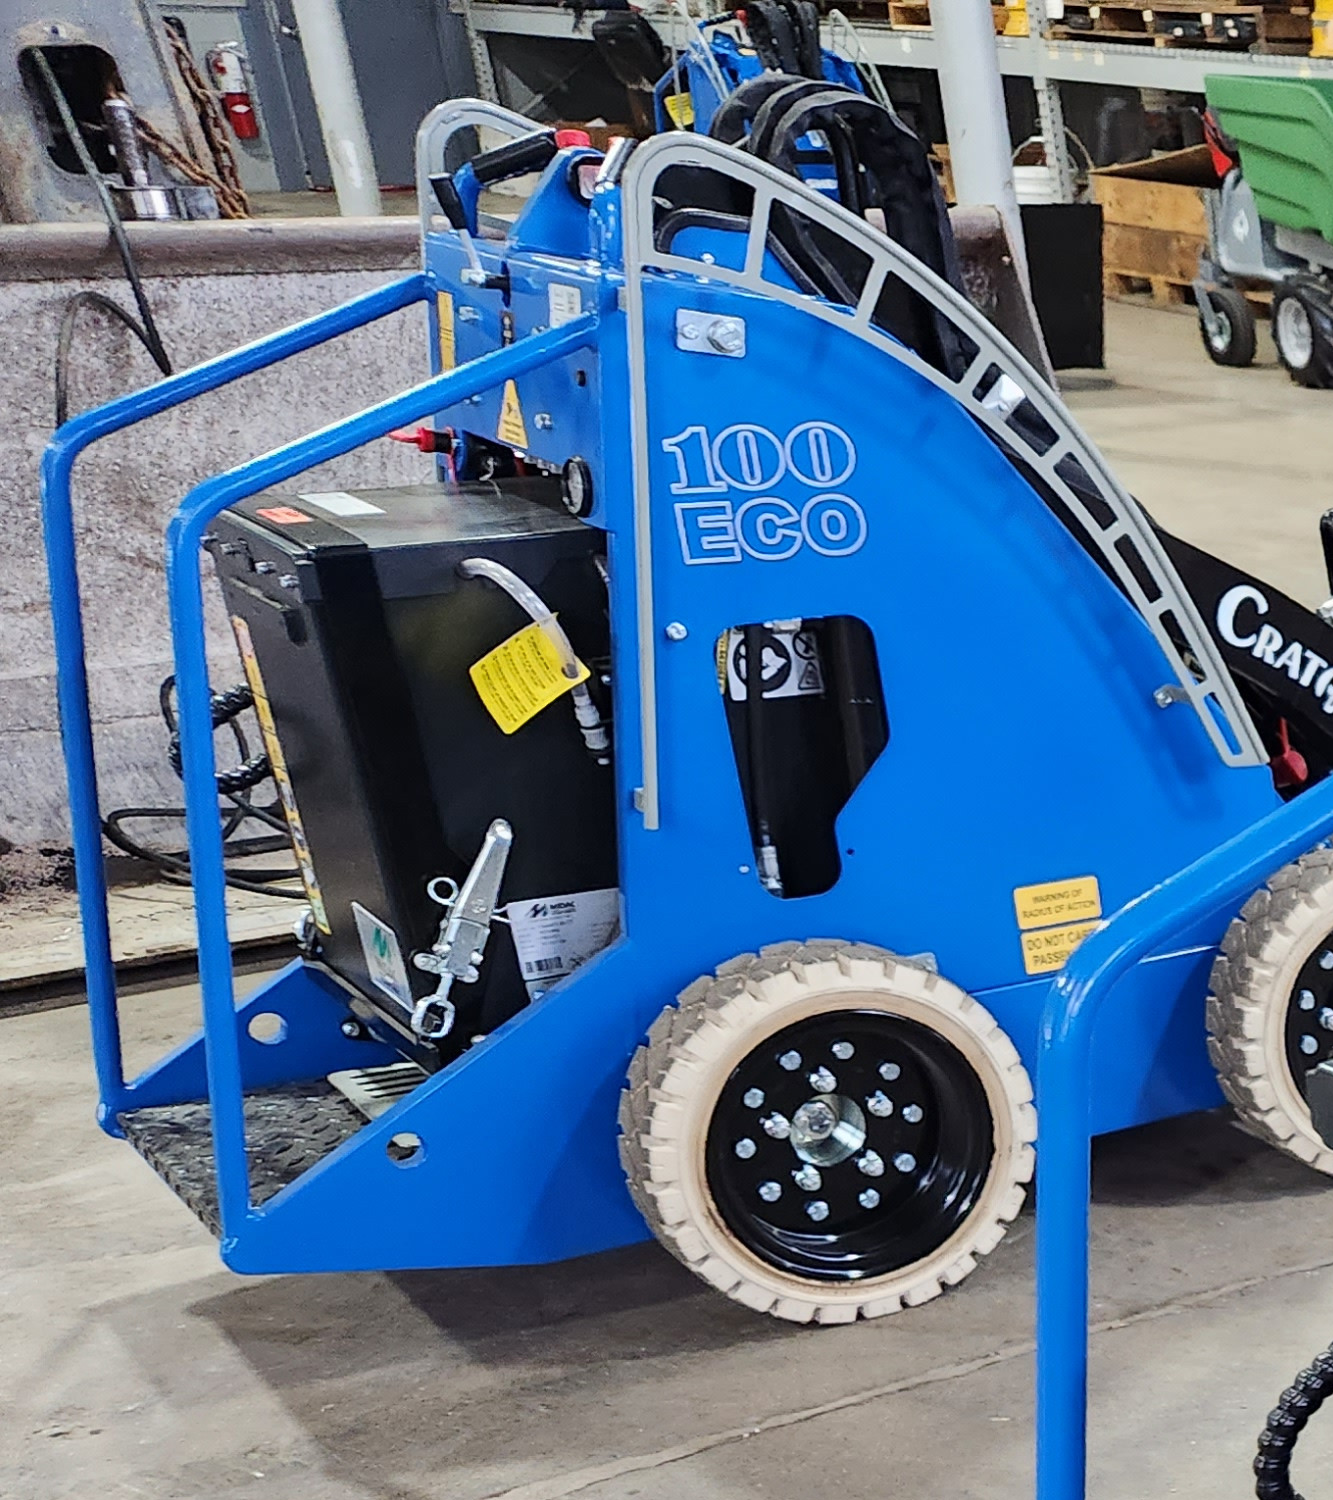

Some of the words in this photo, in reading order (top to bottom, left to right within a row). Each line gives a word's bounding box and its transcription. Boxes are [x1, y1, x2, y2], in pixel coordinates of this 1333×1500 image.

[661, 420, 857, 495] 100
[673, 492, 868, 565] ECO
[1031, 890, 1070, 904] WARNING
[1070, 888, 1082, 898] OF
[1054, 904, 1065, 914] OF
[1067, 899, 1096, 911] ACTION
[1026, 937, 1042, 951] DO
[1044, 933, 1065, 947] NOT
